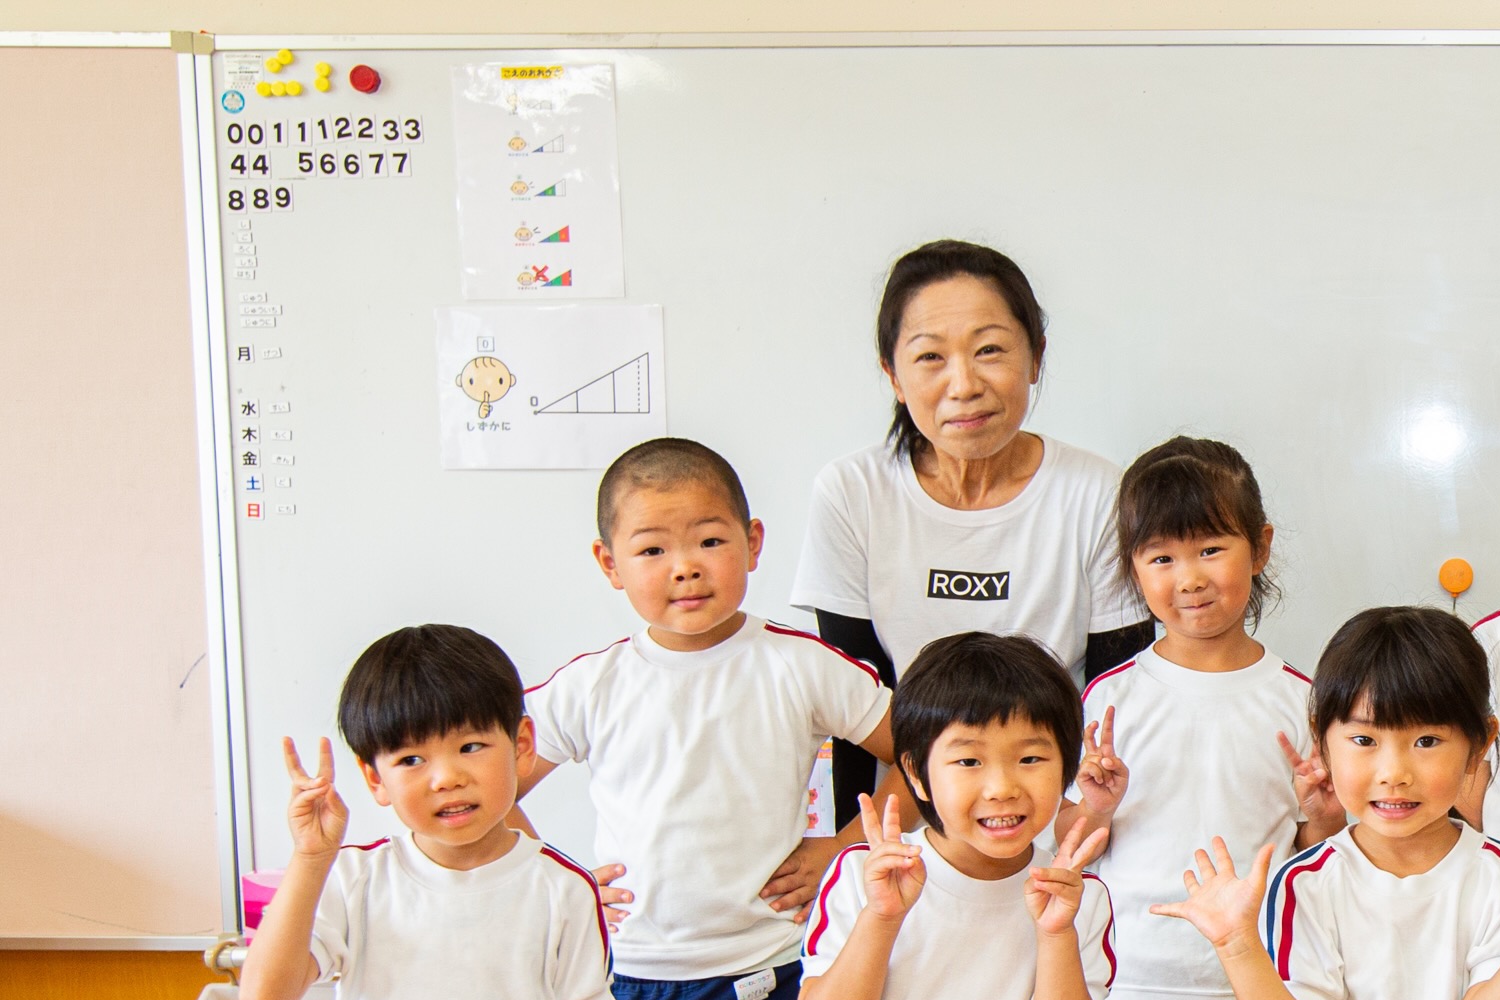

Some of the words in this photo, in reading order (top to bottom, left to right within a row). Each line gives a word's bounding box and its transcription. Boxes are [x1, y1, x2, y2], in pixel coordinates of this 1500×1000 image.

[227, 123, 243, 144] 0
[247, 124, 263, 145] 0
[273, 122, 282, 143] 1
[297, 122, 306, 142] 1
[317, 119, 328, 140] 1
[334, 117, 352, 139] 2
[357, 117, 374, 139] 2
[382, 120, 400, 141] 3
[404, 119, 421, 140] 3
[230, 154, 247, 175] 4
[252, 154, 269, 175] 4
[298, 152, 314, 173] 5
[319, 153, 336, 174] 6
[343, 154, 360, 175] 6
[368, 153, 385, 174] 7
[392, 153, 408, 173] 7
[228, 190, 245, 211] 8
[253, 188, 270, 209] 8
[275, 187, 291, 208] 9
[237, 346, 251, 361] 月
[241, 401, 256, 416] 水
[241, 426, 257, 442] 木
[466, 421, 511, 432] しずかに
[242, 451, 257, 466] 金
[246, 476, 261, 490] 土
[247, 503, 260, 518] 日
[932, 573, 1008, 597] ROXY
